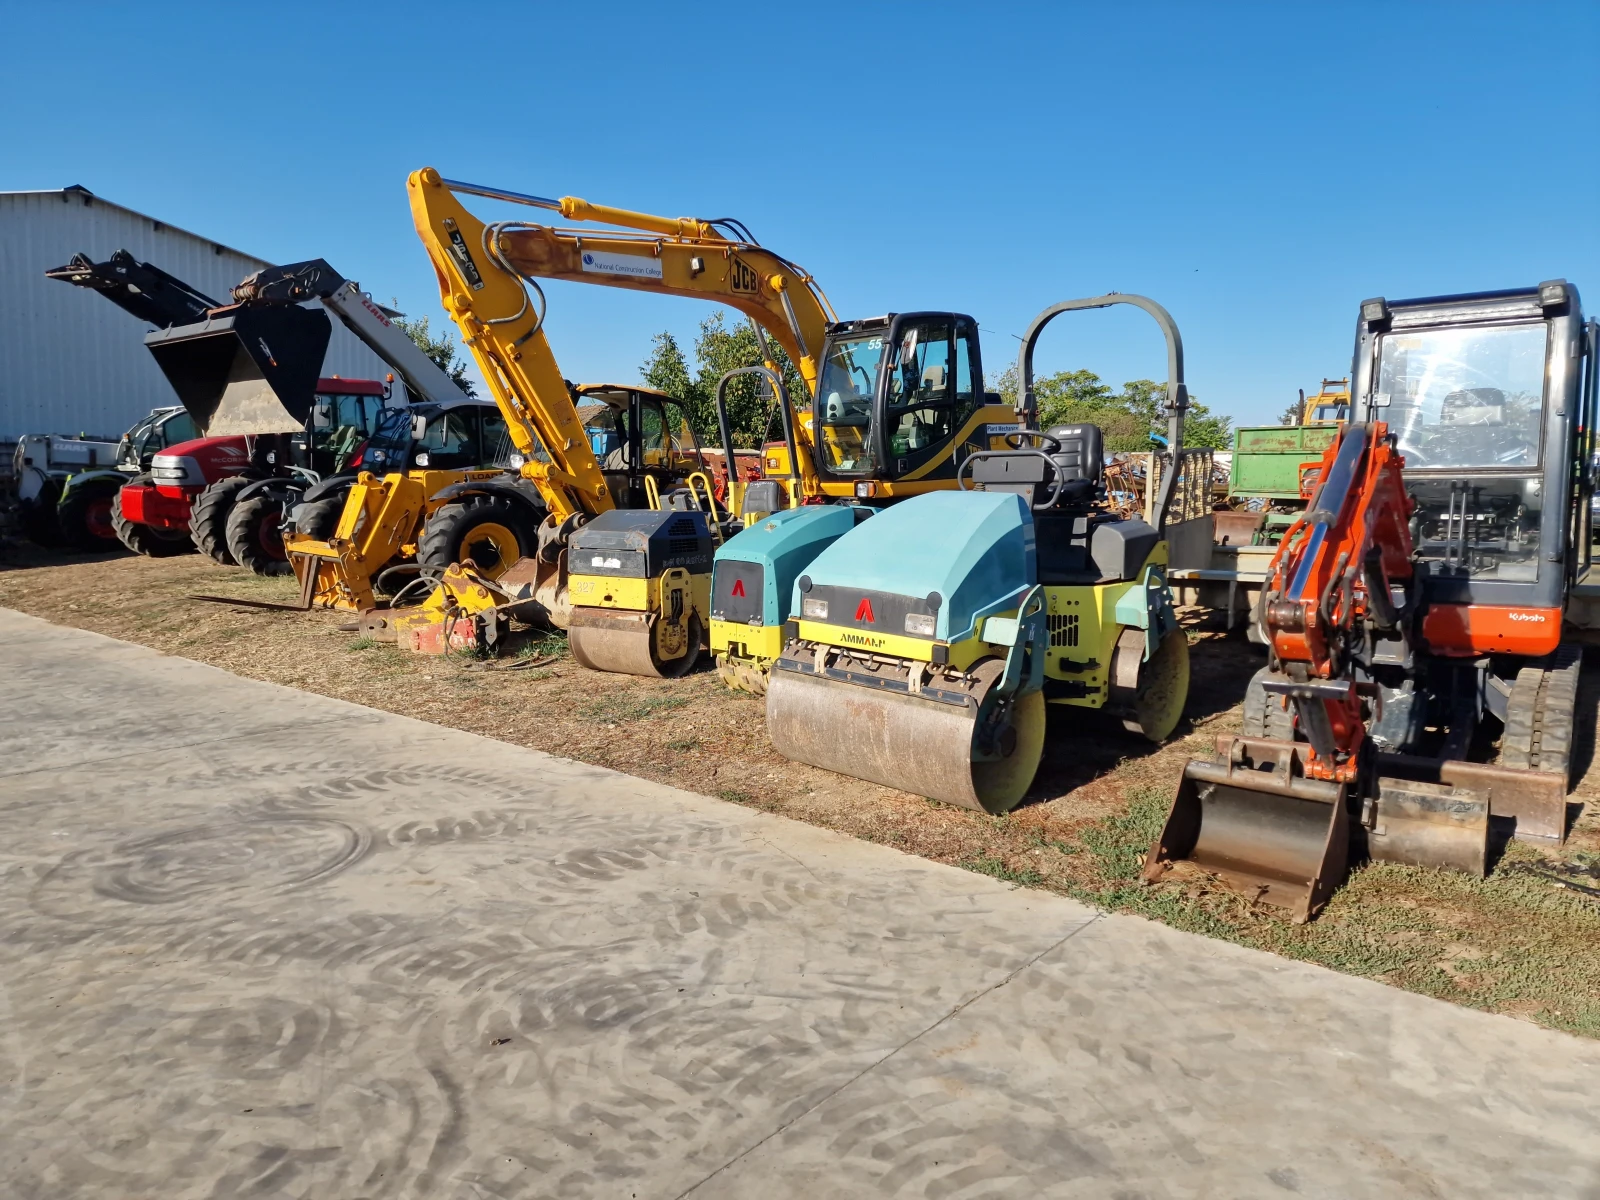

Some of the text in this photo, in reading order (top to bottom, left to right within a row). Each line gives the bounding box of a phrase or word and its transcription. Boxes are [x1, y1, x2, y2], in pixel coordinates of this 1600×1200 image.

[594, 262, 661, 276] National Construction College
[732, 258, 757, 291] JCB
[361, 299, 391, 327] CLAAS
[867, 338, 883, 350] 55
[53, 443, 88, 451] CLAAS
[576, 581, 595, 593] 327
[1508, 612, 1546, 622] Kubota
